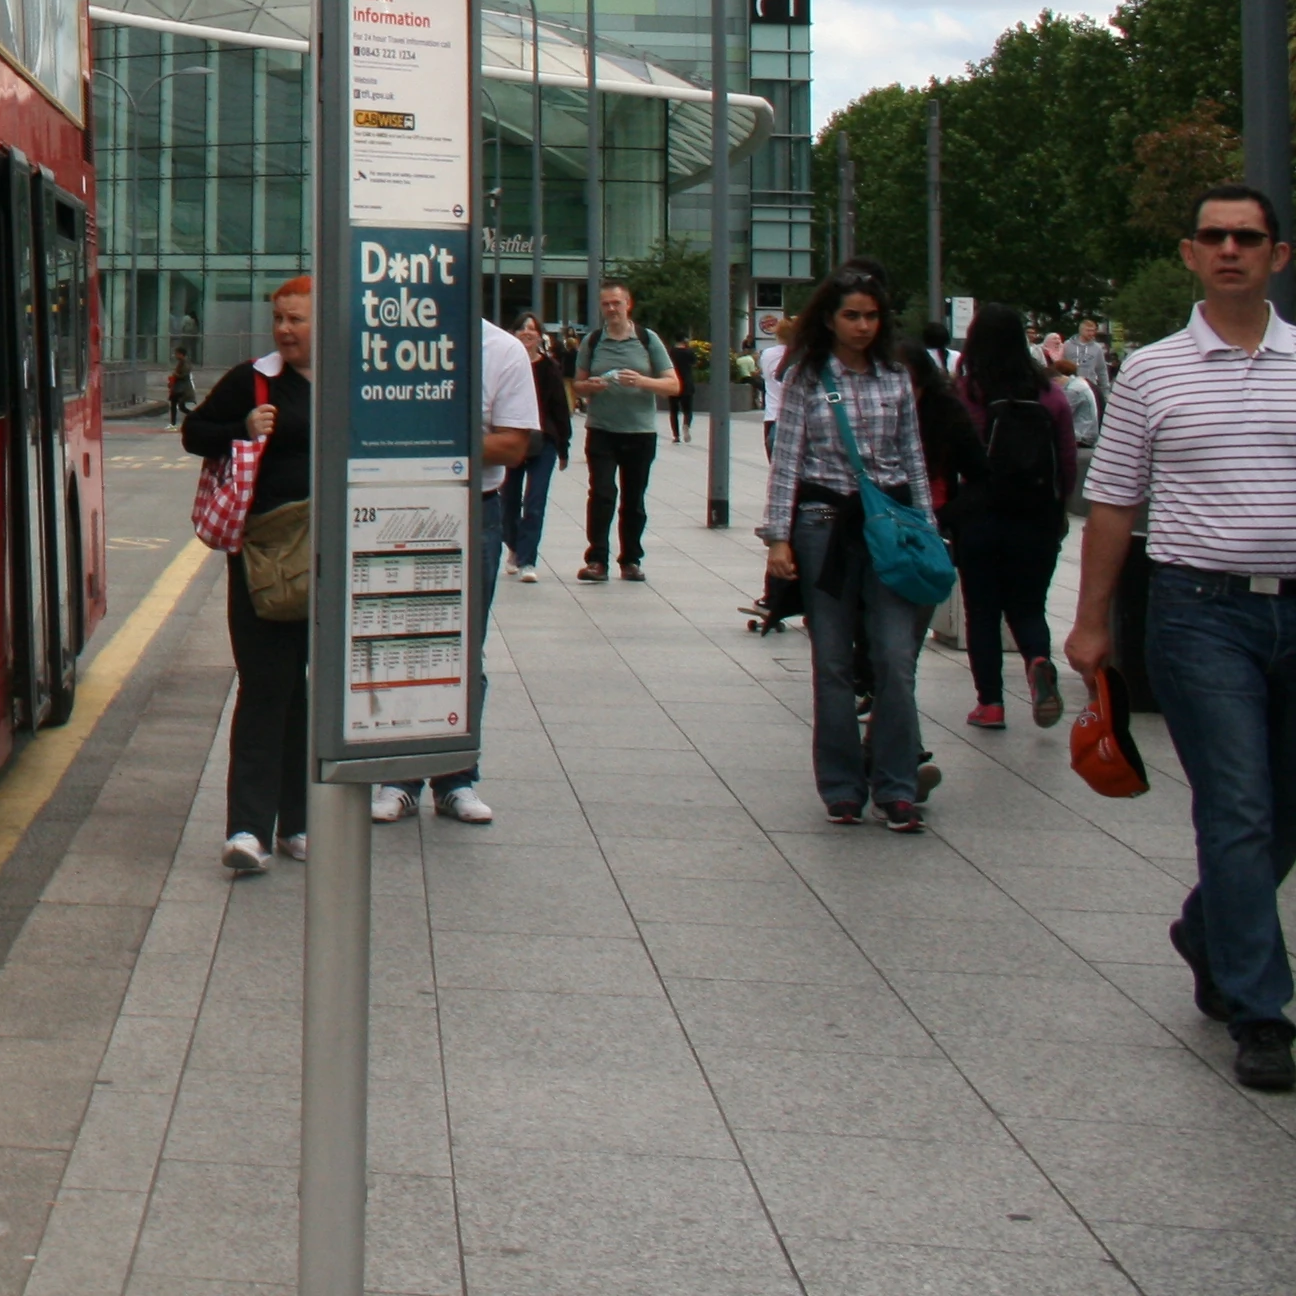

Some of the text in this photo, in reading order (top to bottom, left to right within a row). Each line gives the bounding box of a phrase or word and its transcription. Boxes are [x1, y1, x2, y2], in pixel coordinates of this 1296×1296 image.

[353, 6, 431, 28] information
[383, 49, 396, 59] 222
[362, 287, 437, 329] t@ke
[395, 334, 454, 371] out
[361, 380, 454, 400] on our staff
[354, 508, 376, 522] 228
